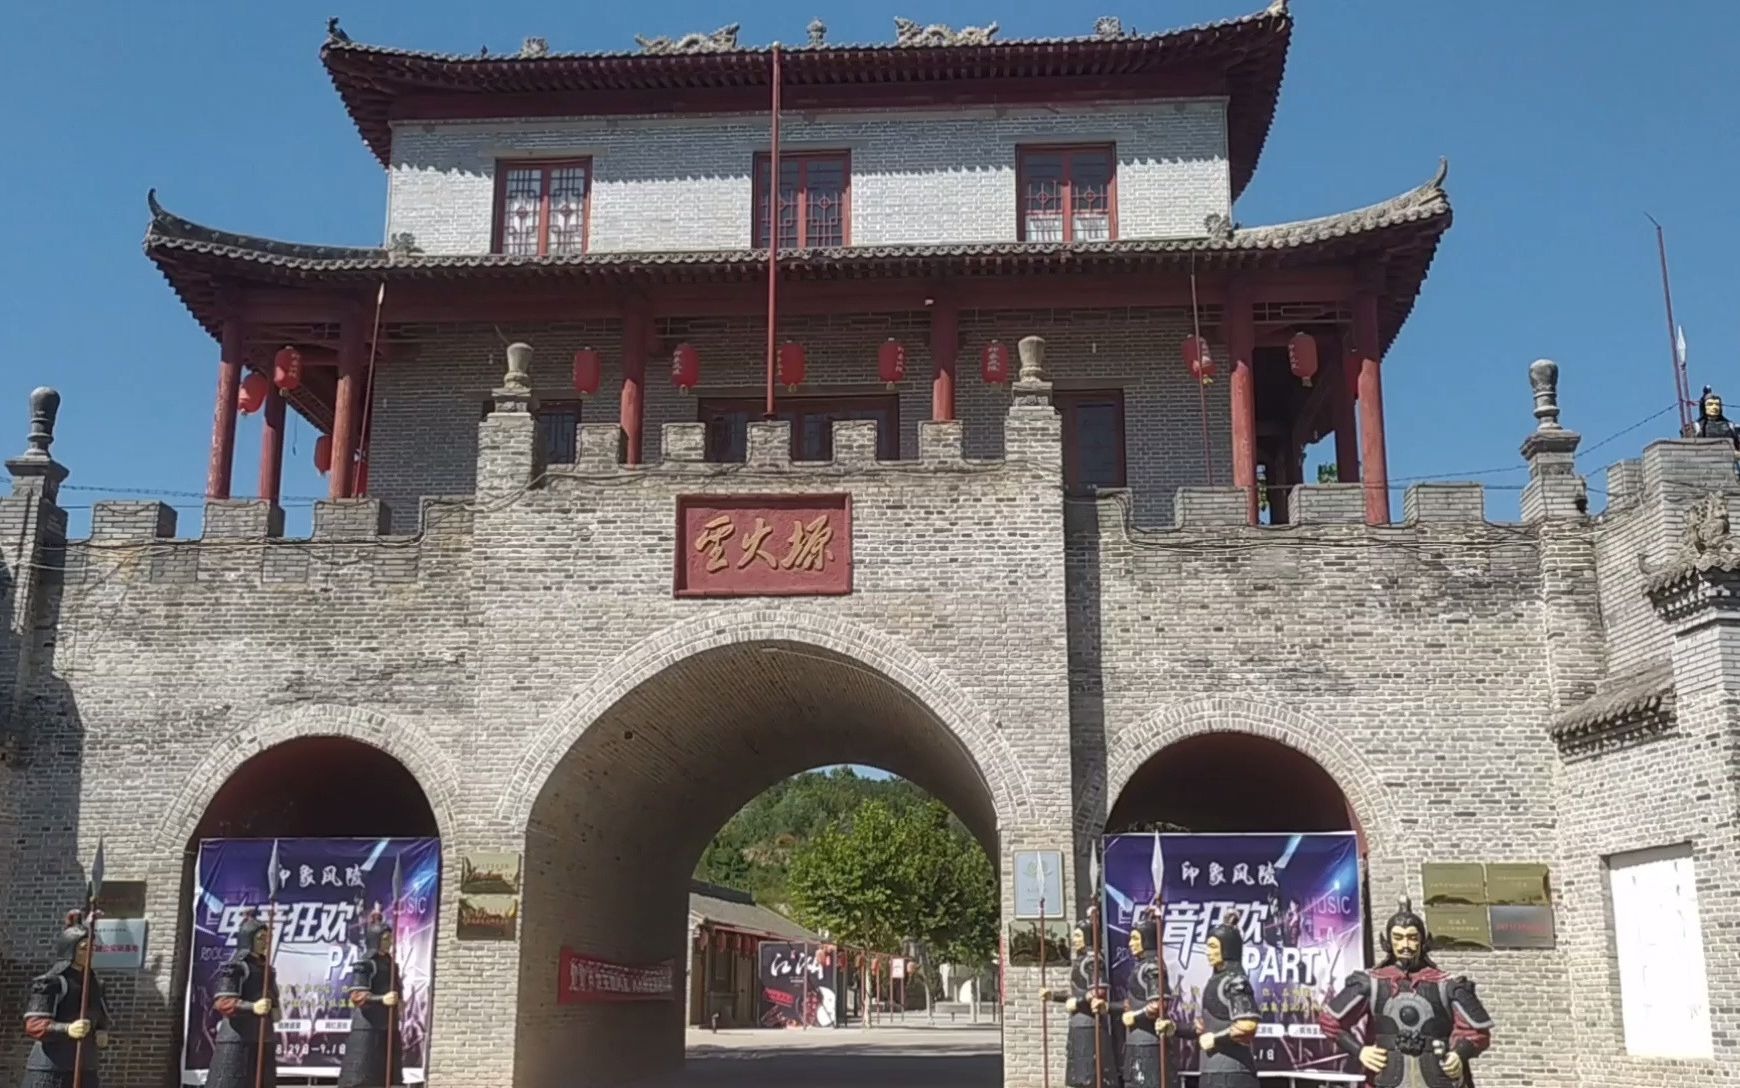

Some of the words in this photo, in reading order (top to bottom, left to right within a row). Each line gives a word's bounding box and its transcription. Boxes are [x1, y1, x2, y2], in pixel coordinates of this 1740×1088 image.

[1181, 861, 1279, 887] 印象风陵
[393, 896, 427, 914] USIC
[1242, 946, 1344, 984] PARTY
